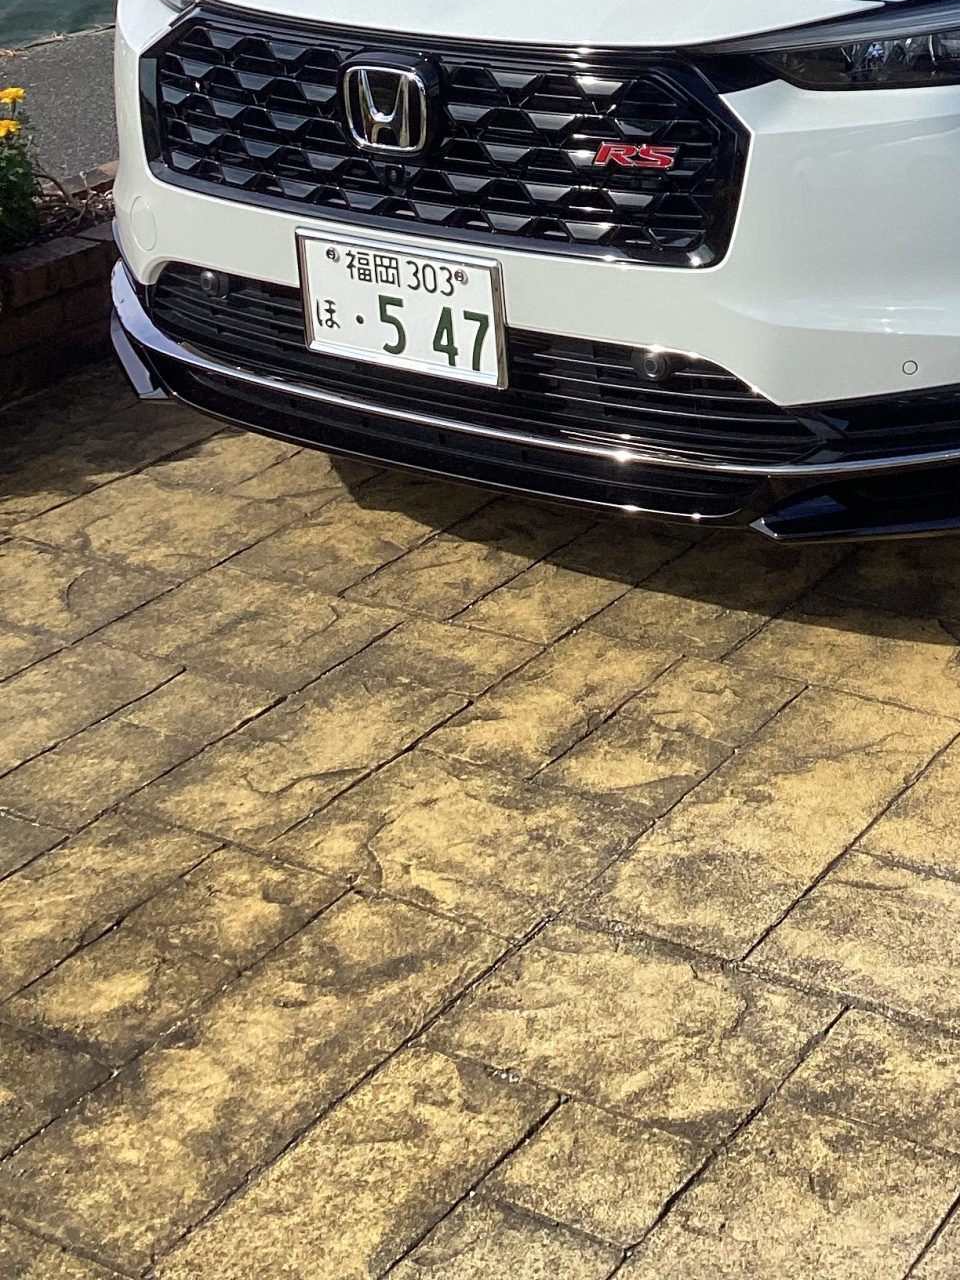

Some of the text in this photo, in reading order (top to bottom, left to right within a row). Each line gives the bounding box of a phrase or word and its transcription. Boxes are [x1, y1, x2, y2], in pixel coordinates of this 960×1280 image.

[592, 141, 680, 170] RS
[345, 249, 455, 297] 福岡 303
[316, 298, 341, 329] ほ
